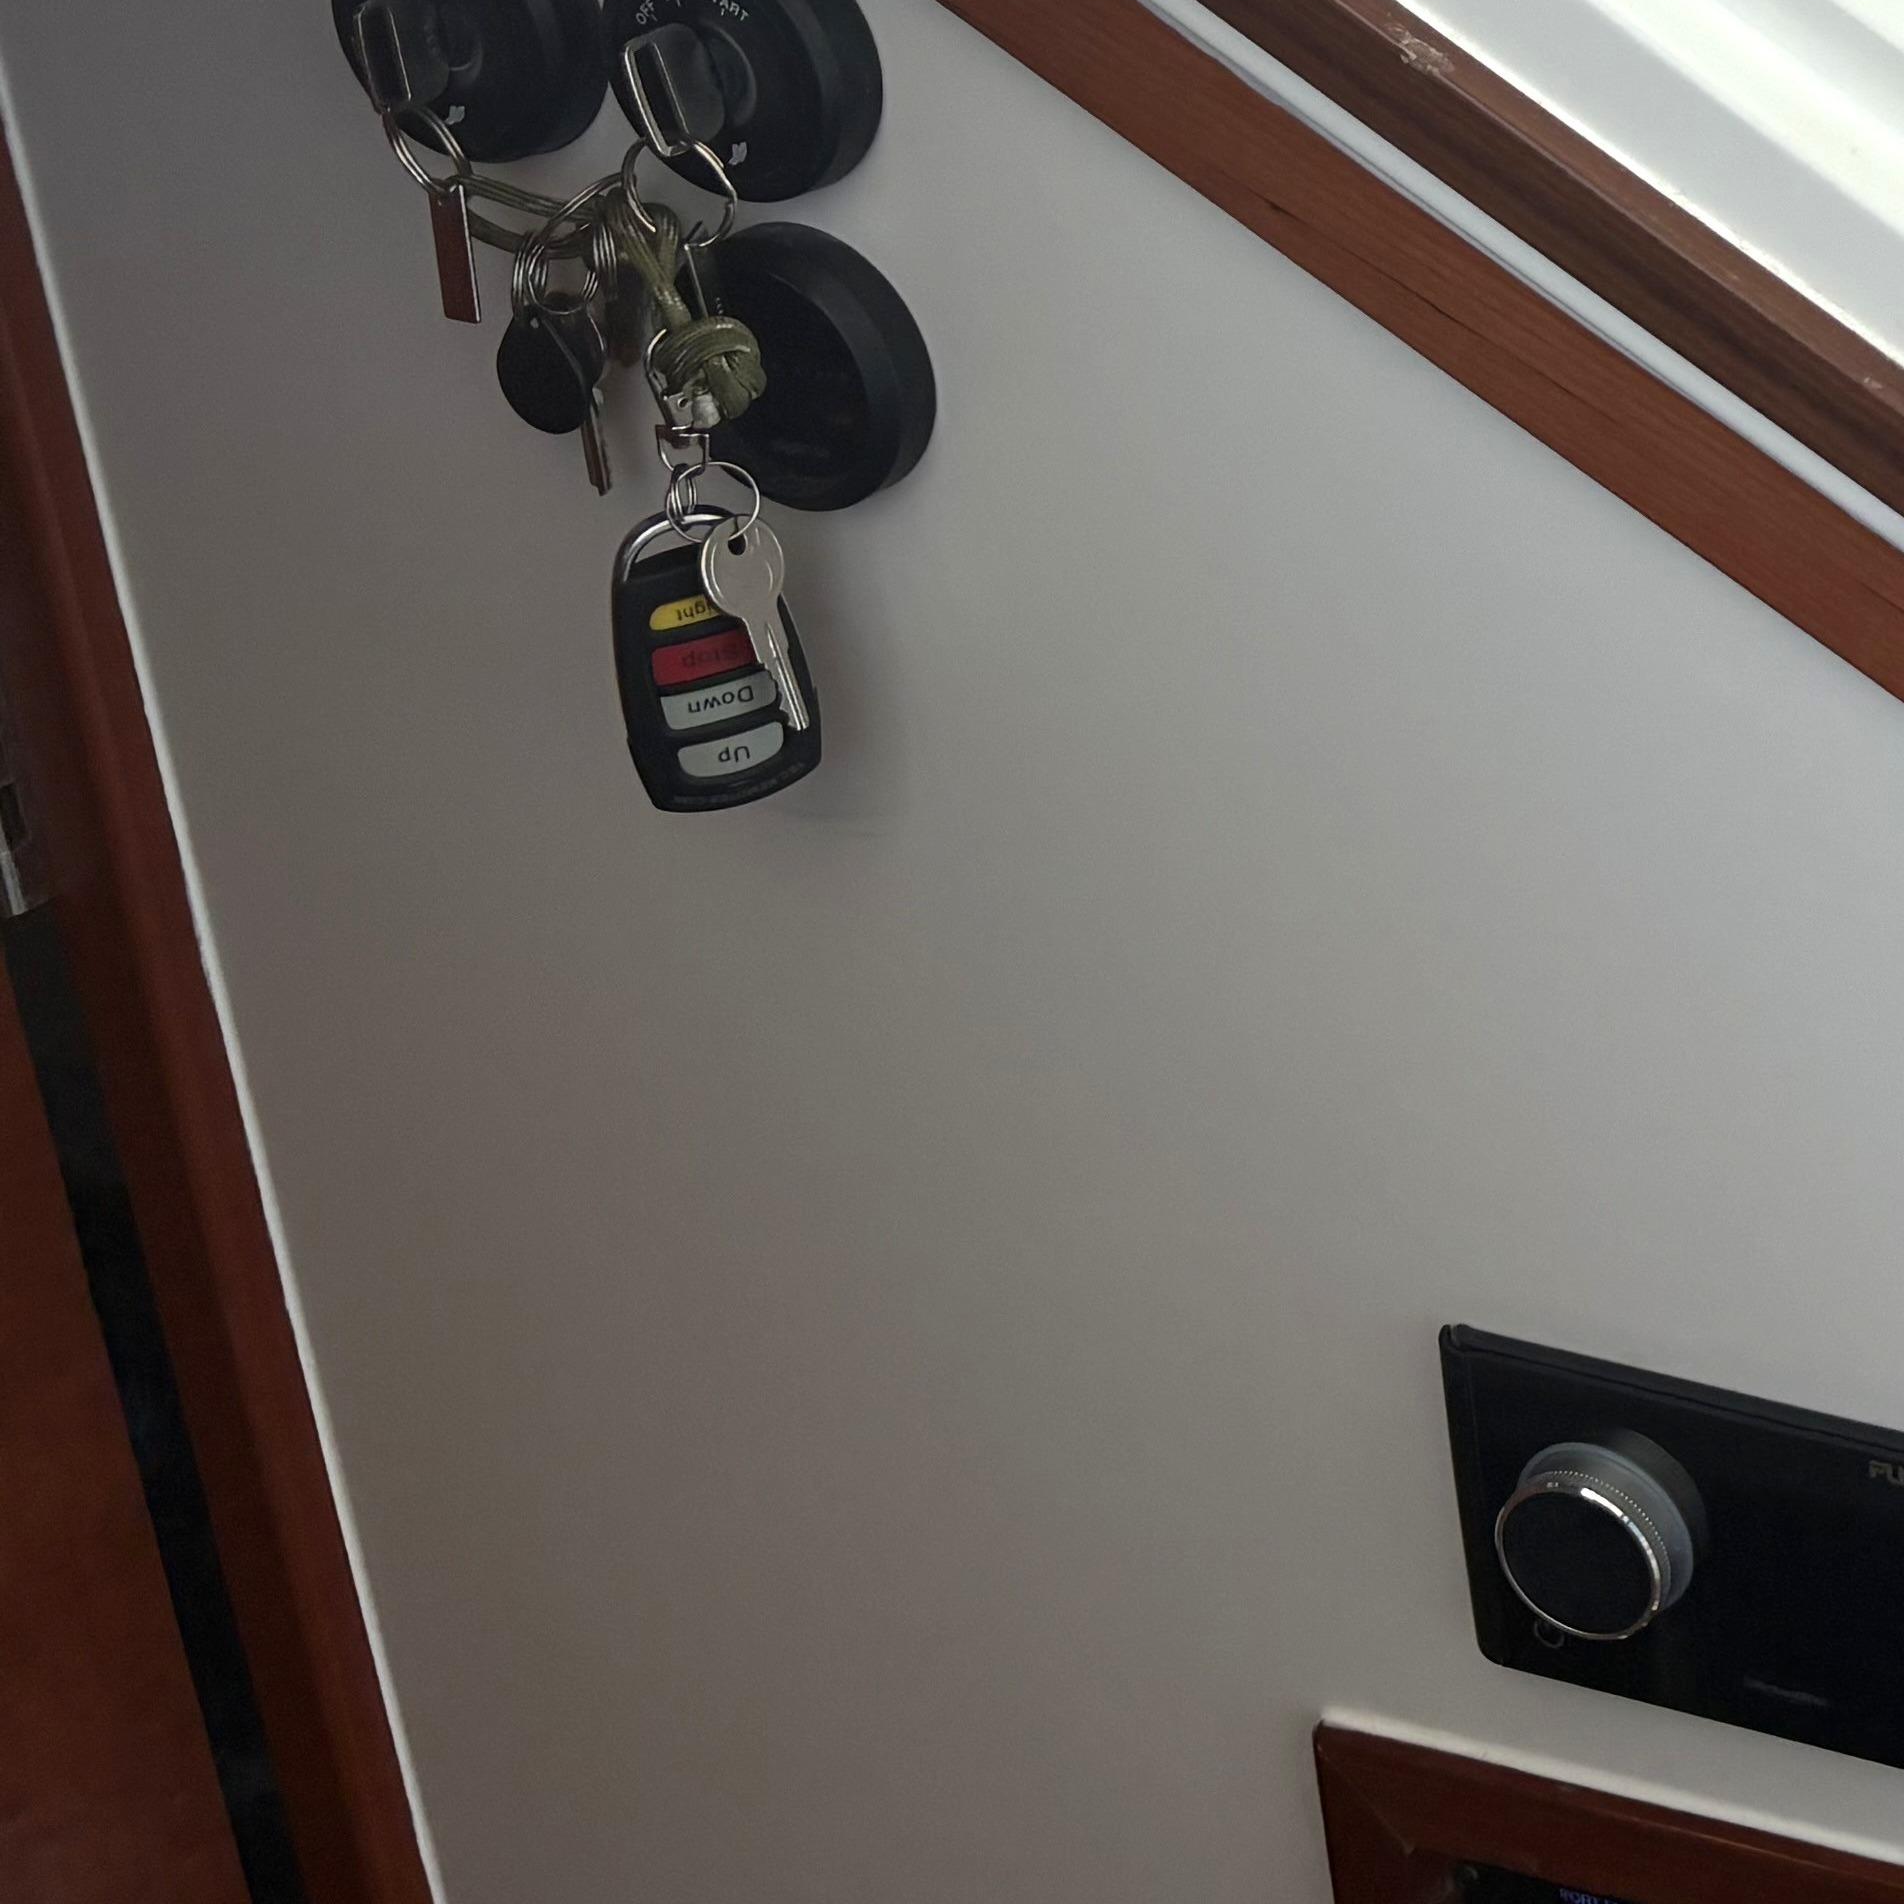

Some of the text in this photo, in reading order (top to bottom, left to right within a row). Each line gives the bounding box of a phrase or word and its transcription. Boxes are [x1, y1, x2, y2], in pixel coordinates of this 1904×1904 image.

[681, 643, 739, 671] Stop
[686, 685, 754, 713] Down
[716, 745, 752, 764] Up
